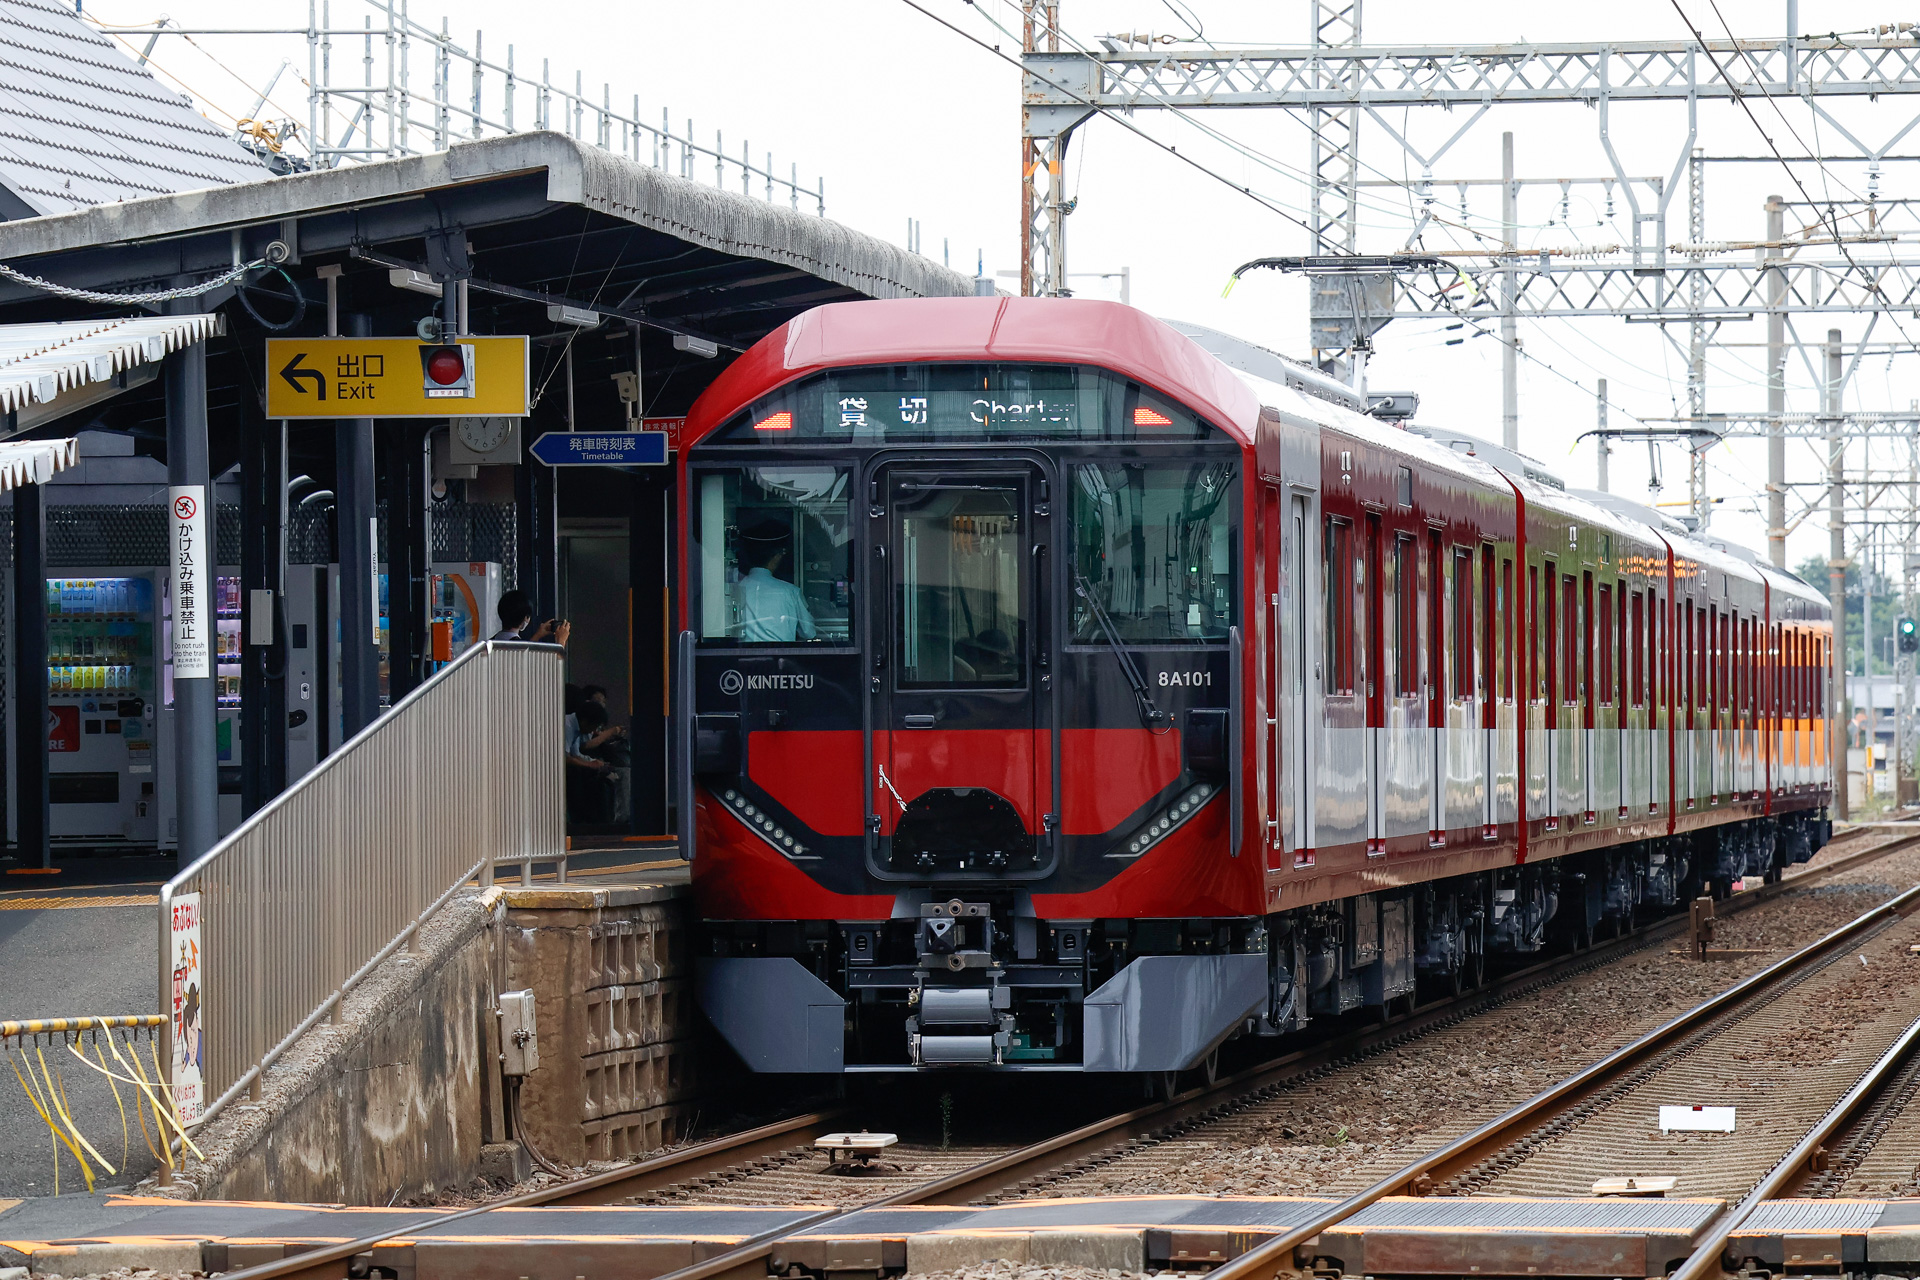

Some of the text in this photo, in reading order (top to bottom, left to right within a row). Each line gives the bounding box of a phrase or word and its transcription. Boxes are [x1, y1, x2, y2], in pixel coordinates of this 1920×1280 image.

[337, 353, 384, 378] 出口
[337, 381, 375, 400] Exit
[569, 437, 636, 451] 発車時刻表
[581, 452, 624, 460] Timetable
[178, 522, 196, 640] かけ込み乗車禁止
[193, 641, 205, 649] rush
[747, 674, 814, 689] KINTETSU
[1158, 671, 1212, 686] 8A101
